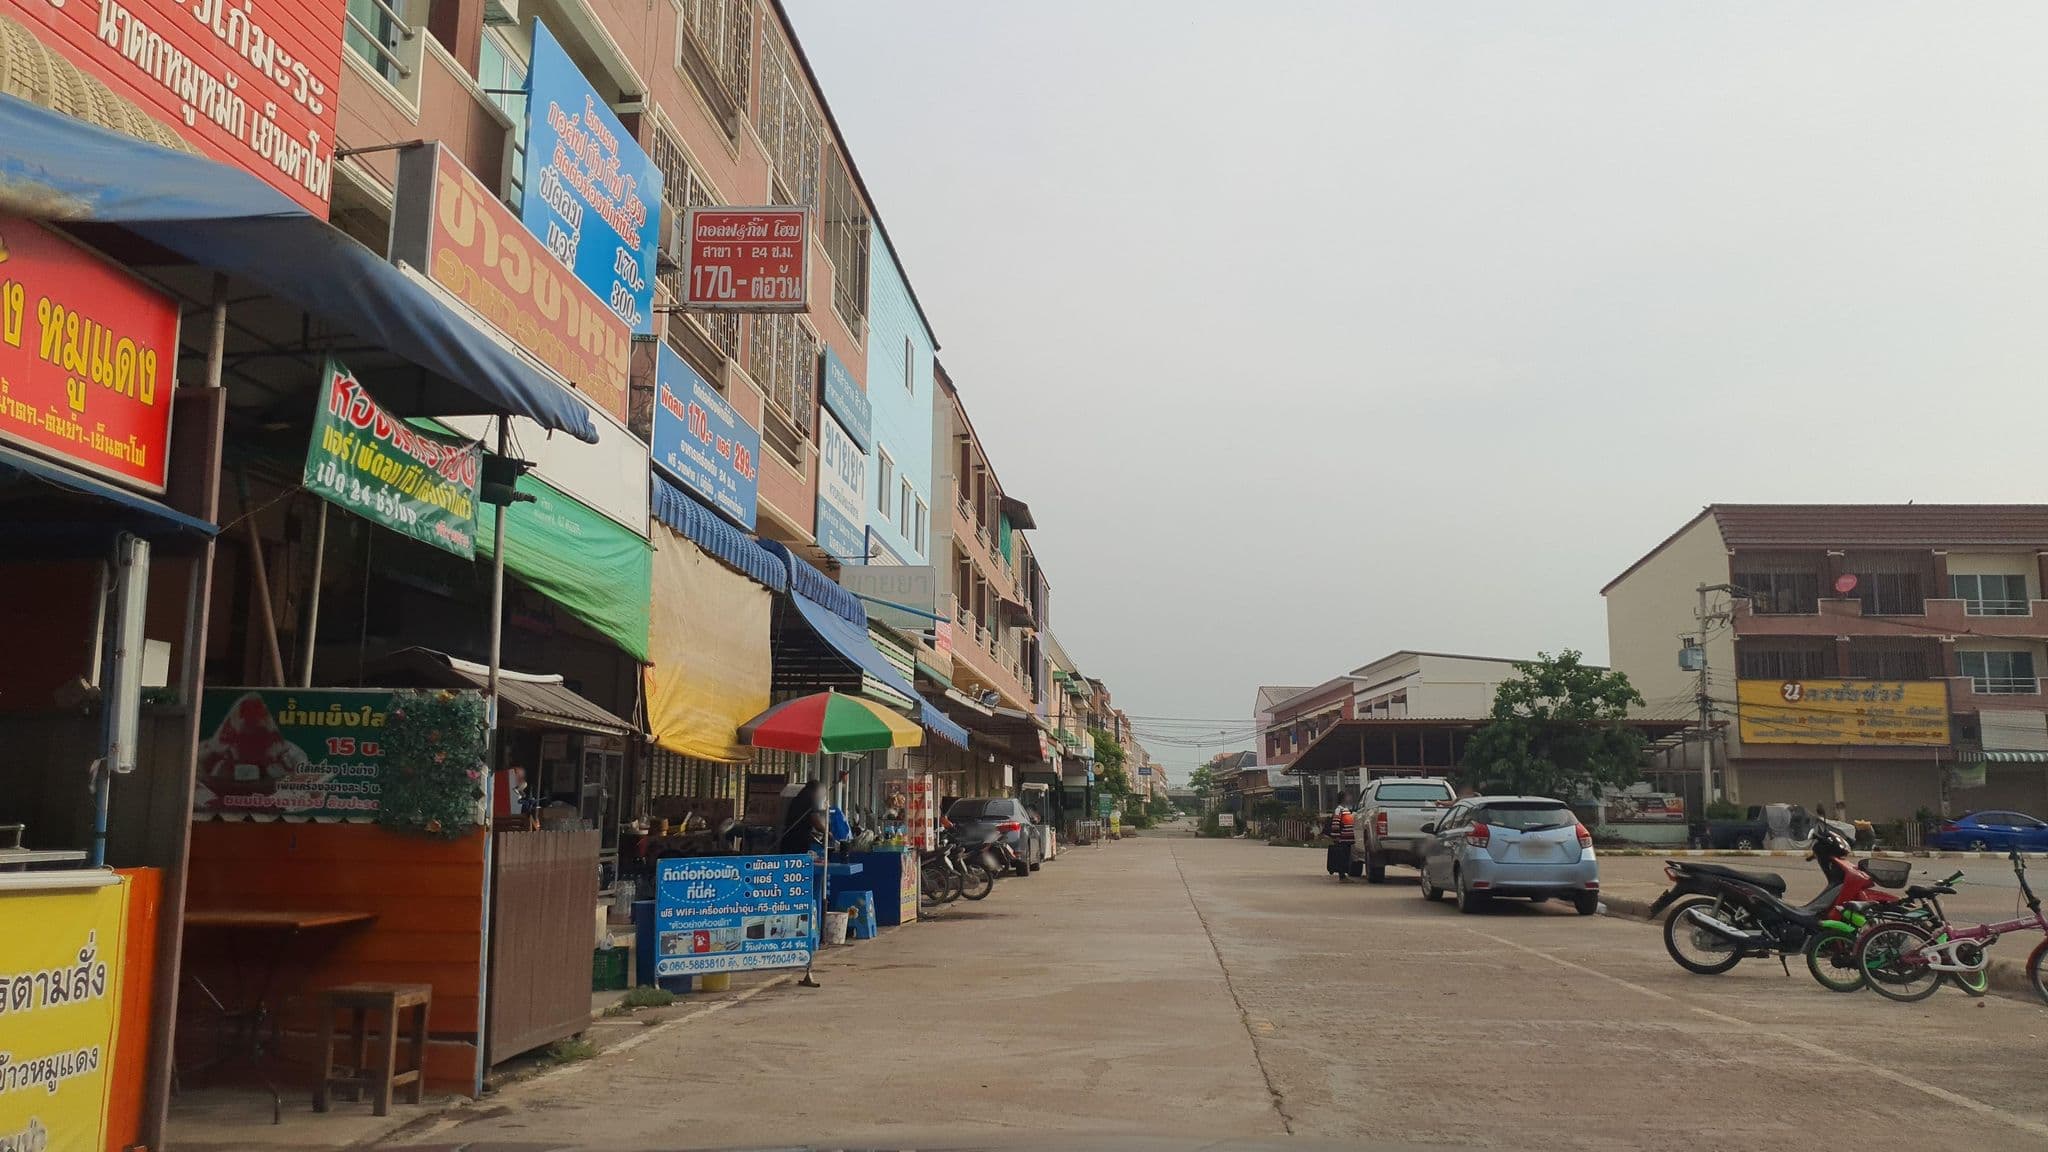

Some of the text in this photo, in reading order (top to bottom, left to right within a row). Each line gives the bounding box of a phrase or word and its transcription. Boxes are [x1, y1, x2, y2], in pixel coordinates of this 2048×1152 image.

[540, 166, 584, 231] พัดลม
[702, 246, 731, 258] สาขา
[737, 247, 742, 258] 1
[751, 247, 767, 258] 24
[439, 169, 629, 392] ข้าวขาหมู
[37, 296, 158, 414] หมูแดง
[278, 698, 386, 727] น้ำแข็งใส
[325, 737, 355, 756] 15
[662, 864, 741, 882] ติดต่อห้องพัก
[752, 858, 781, 871] พัดลม
[753, 872, 773, 884] แอร์
[752, 883, 782, 898] อาบน้ำ
[781, 940, 793, 950] 24
